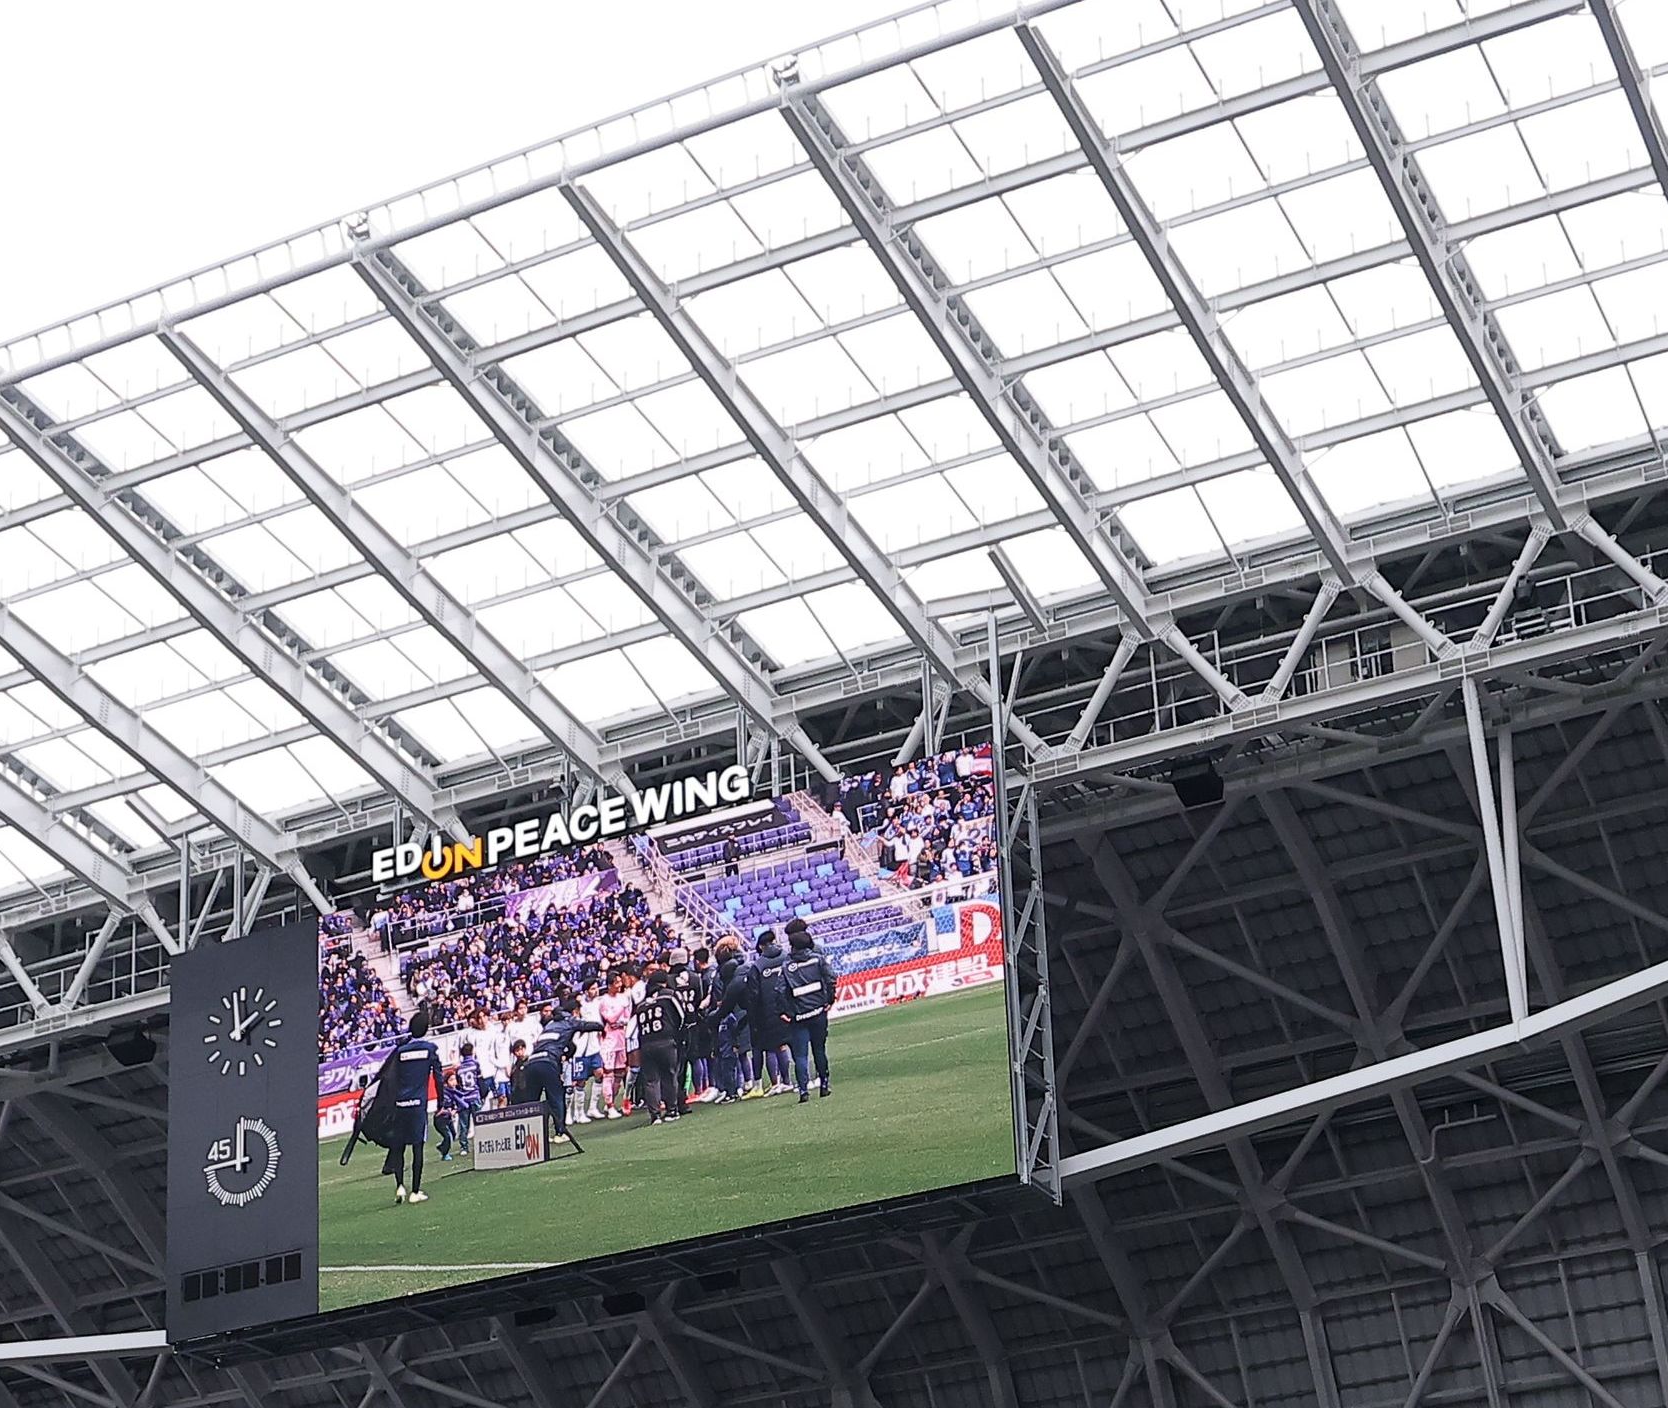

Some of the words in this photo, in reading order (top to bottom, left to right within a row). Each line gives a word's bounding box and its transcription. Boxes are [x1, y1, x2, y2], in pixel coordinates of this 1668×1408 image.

[372, 836, 482, 882] EDION
[488, 795, 626, 866] PEACE
[630, 765, 750, 826] WING
[207, 1139, 232, 1161] 45
